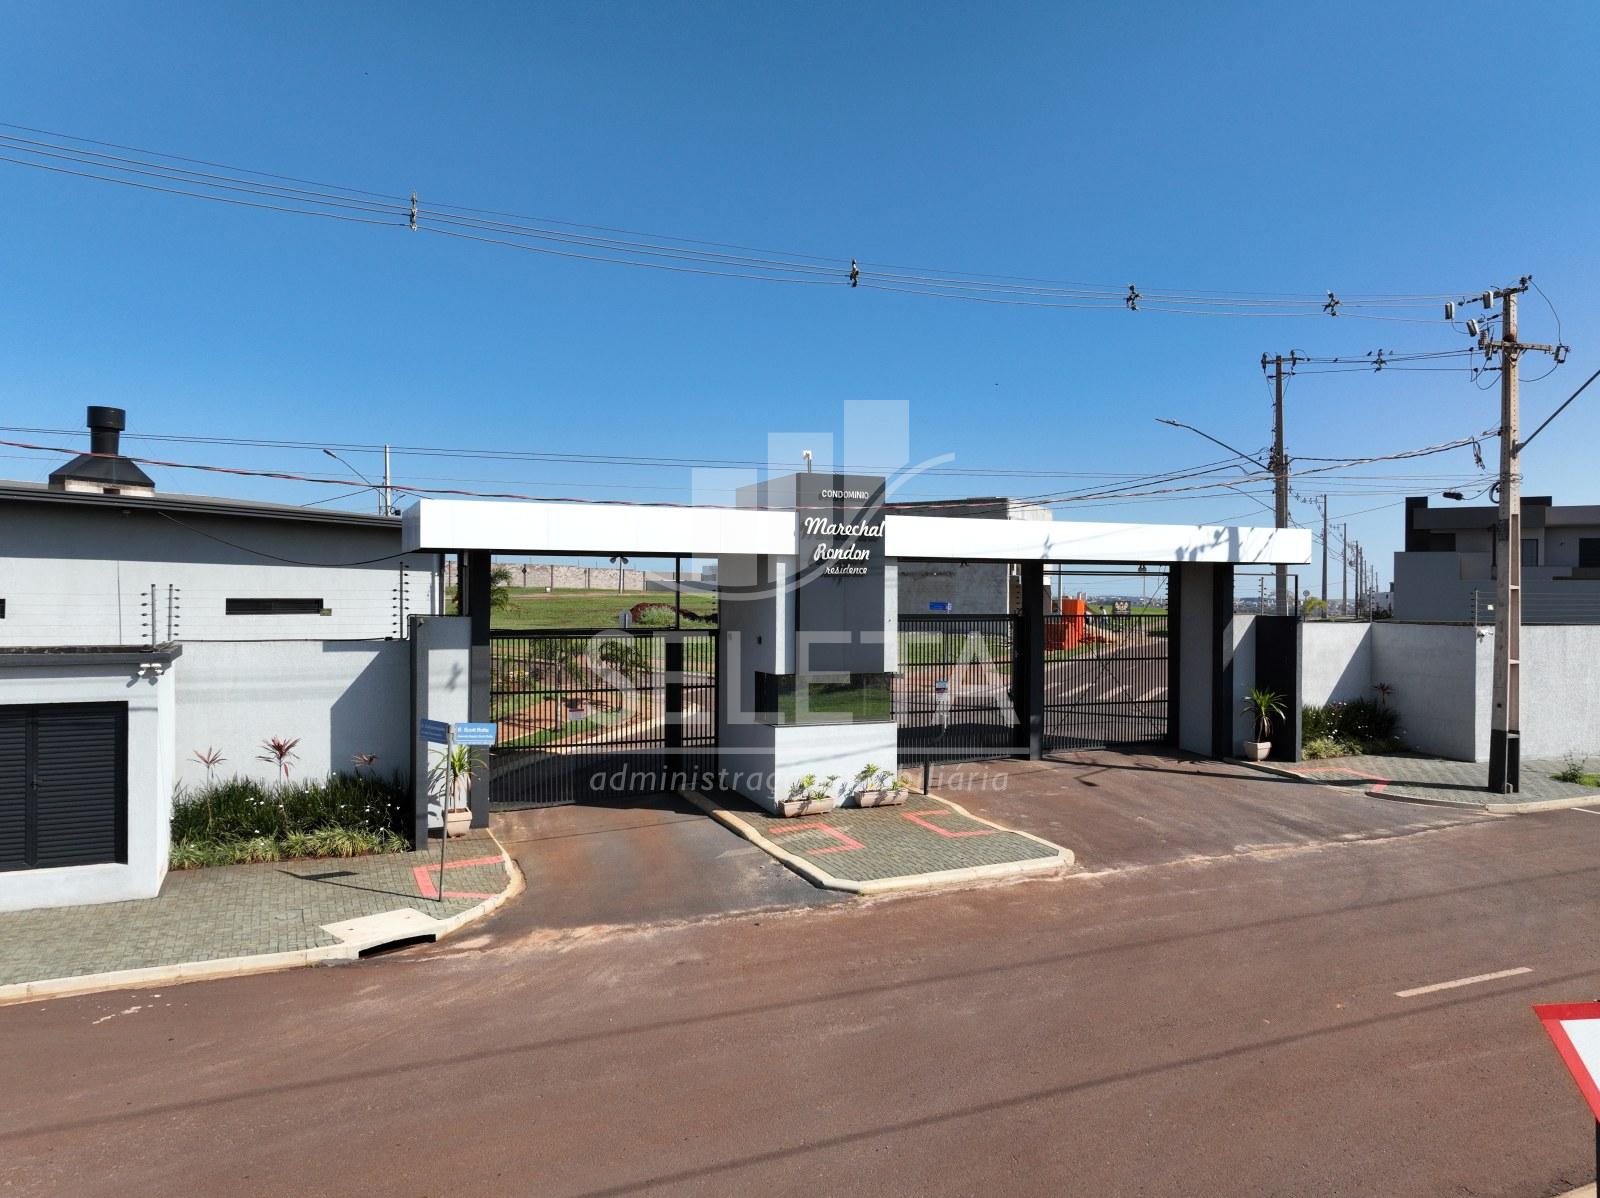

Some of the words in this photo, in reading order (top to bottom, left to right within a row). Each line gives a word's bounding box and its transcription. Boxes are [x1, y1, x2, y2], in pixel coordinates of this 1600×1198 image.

[821, 489, 870, 500] CONDOMINIO
[804, 517, 886, 537] Marechal
[813, 543, 870, 561] Rondon
[824, 564, 868, 575] residence
